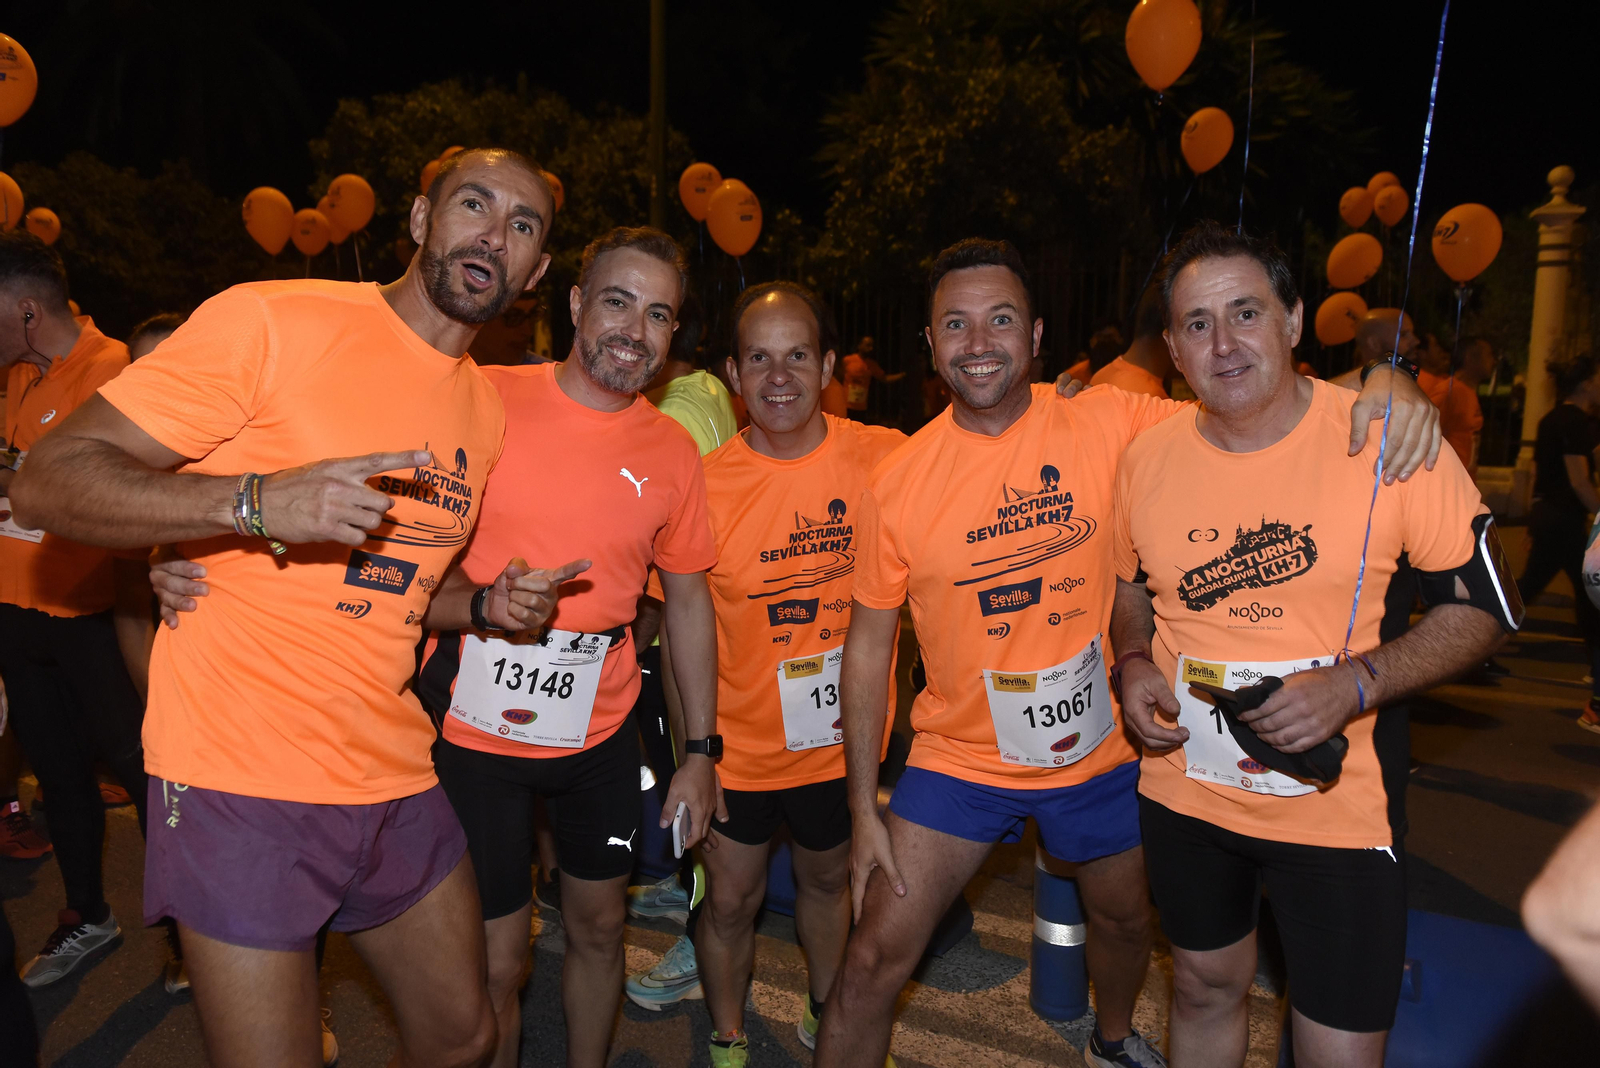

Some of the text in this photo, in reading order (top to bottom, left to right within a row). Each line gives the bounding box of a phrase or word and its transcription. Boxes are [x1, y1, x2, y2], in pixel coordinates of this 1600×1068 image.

[378, 475, 440, 506] SEVILLA
[413, 467, 472, 499] NOCTURNA
[997, 492, 1074, 519] NOCTURNA
[789, 525, 853, 544] NOCTURNA
[966, 517, 1034, 544] SEVILLA
[760, 542, 818, 563] SEVILLA
[1182, 536, 1306, 591] LA NOCTURNA
[1188, 567, 1257, 600] GUADALQUIVIR
[493, 657, 575, 700] 13148
[810, 683, 843, 709] 13
[1023, 681, 1093, 728] 13067
